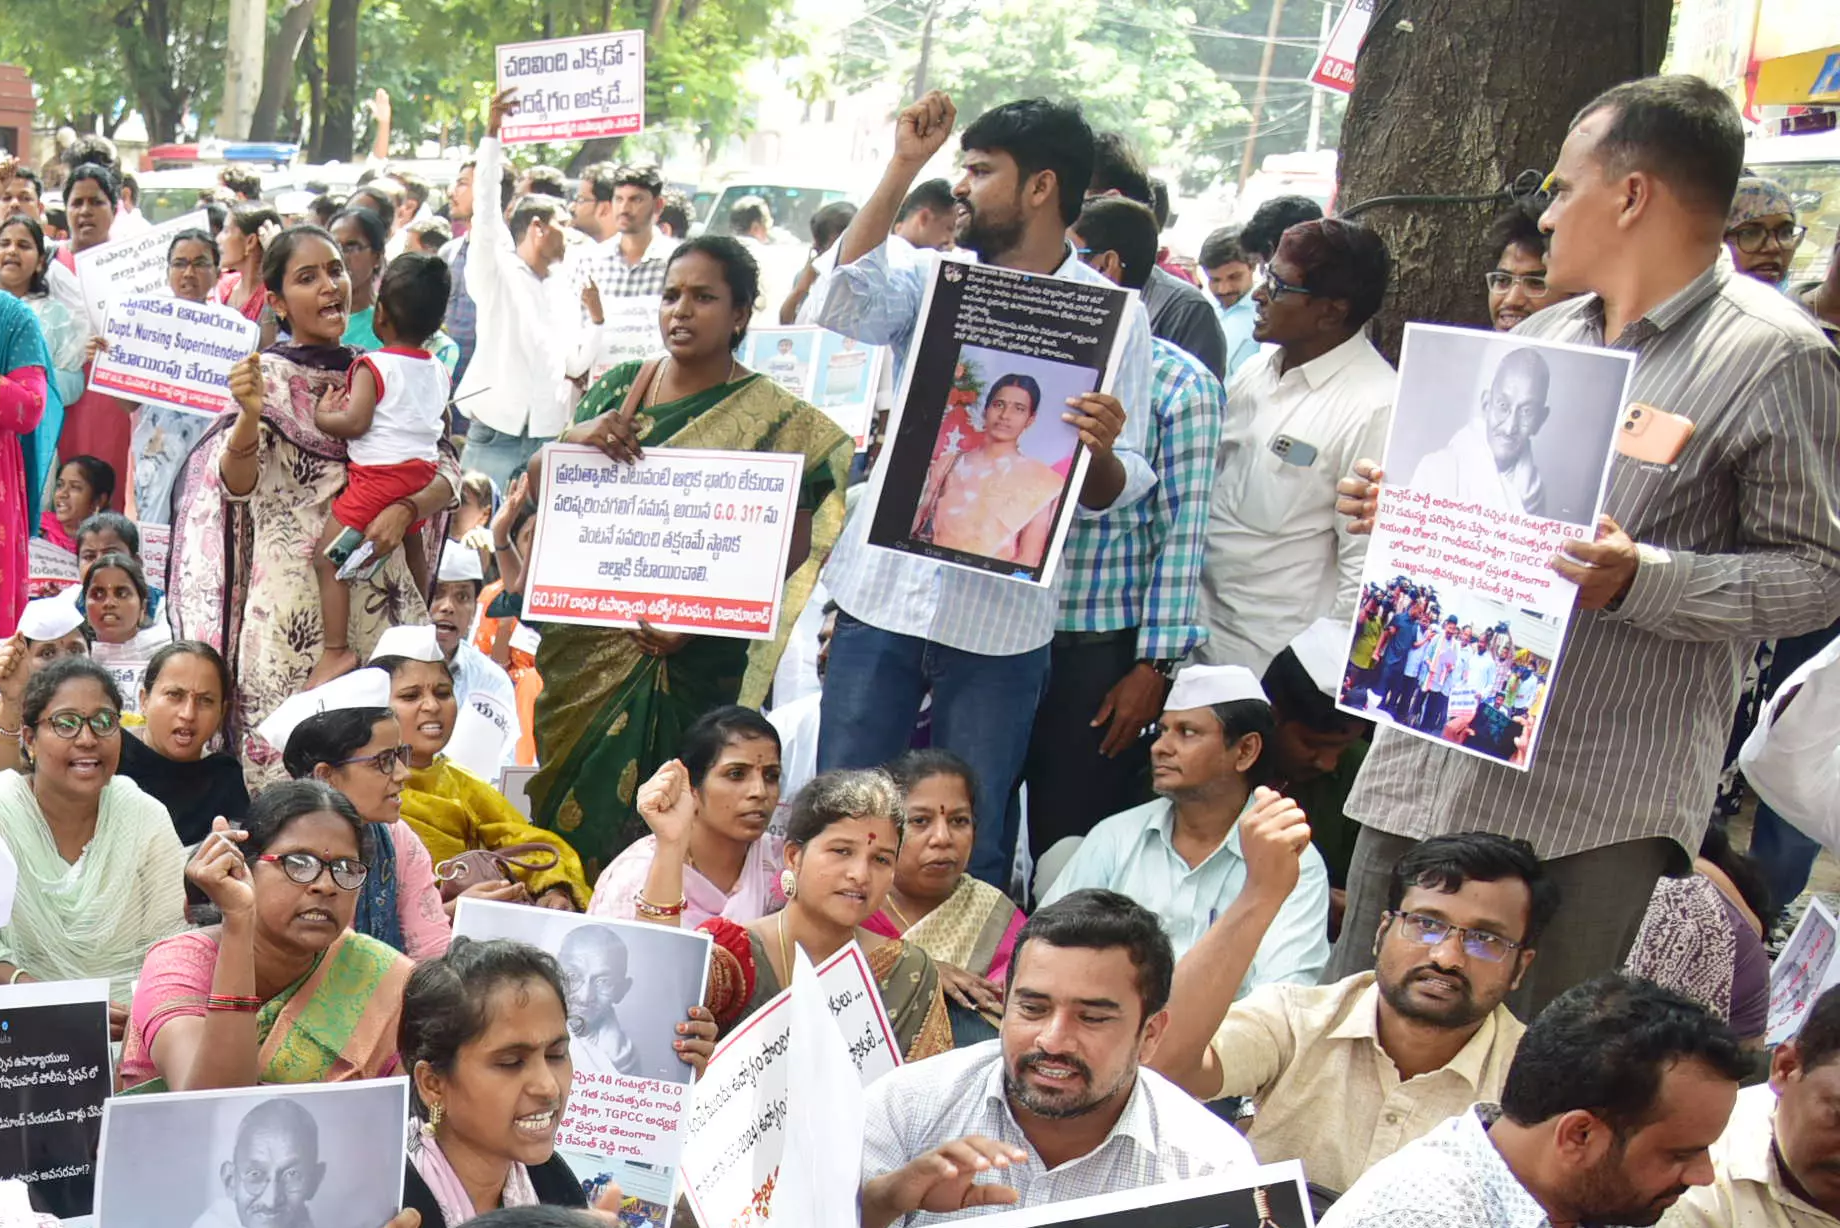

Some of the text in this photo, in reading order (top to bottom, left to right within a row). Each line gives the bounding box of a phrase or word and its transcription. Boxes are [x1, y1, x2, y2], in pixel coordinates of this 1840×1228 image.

[504, 40, 624, 77] చదివింది ఎక్కడో
[178, 306, 246, 334] ఆధారంగా
[134, 323, 171, 350] Nursing
[705, 473, 736, 492] భారం
[738, 472, 784, 492] లేకుండా
[637, 502, 670, 525] సమస్య
[674, 502, 710, 520] అయిన
[741, 505, 762, 522] 317
[764, 507, 778, 524] ను
[578, 526, 742, 560] వెంటనే సవరించి తక్షణమే స్థానిక
[531, 591, 568, 608] GO.317
